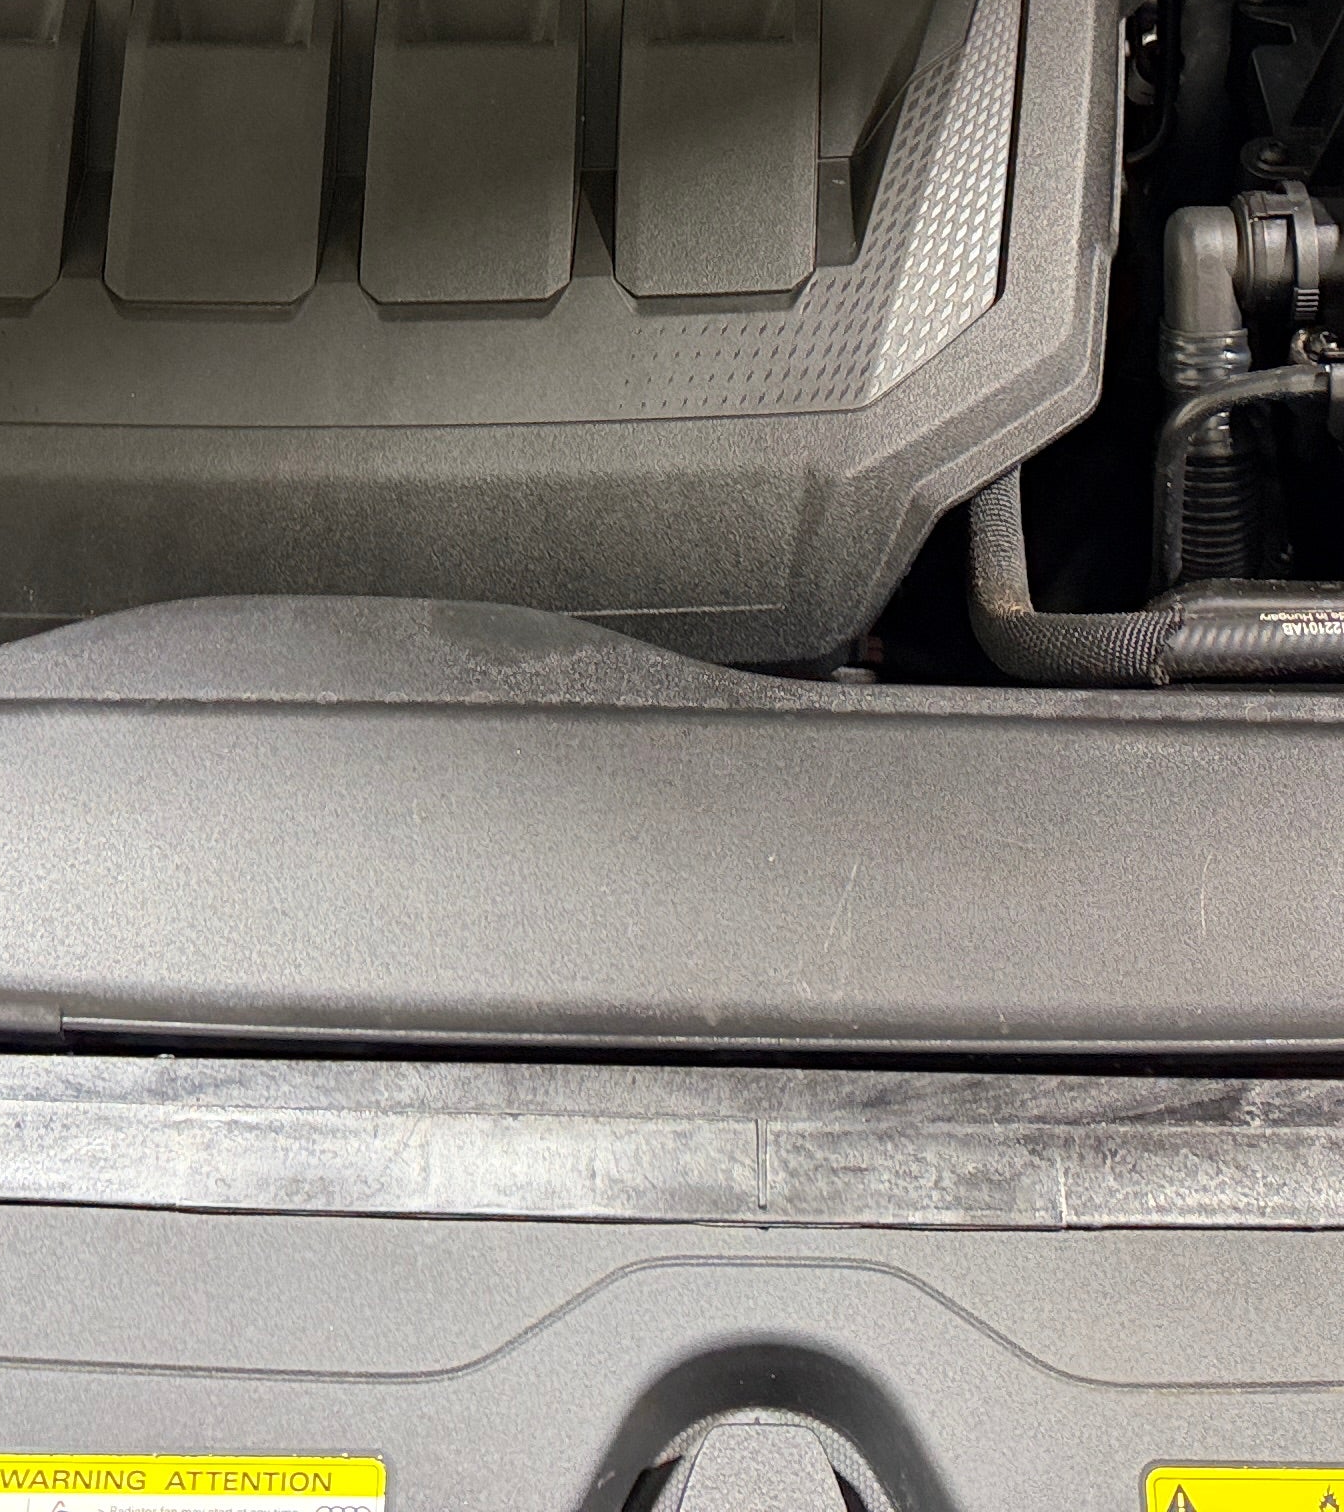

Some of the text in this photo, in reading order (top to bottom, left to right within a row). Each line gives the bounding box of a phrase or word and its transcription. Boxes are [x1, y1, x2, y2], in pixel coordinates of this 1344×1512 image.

[1259, 611, 1314, 622] Hungary
[0, 1469, 333, 1493] WARNING ATTENTION
